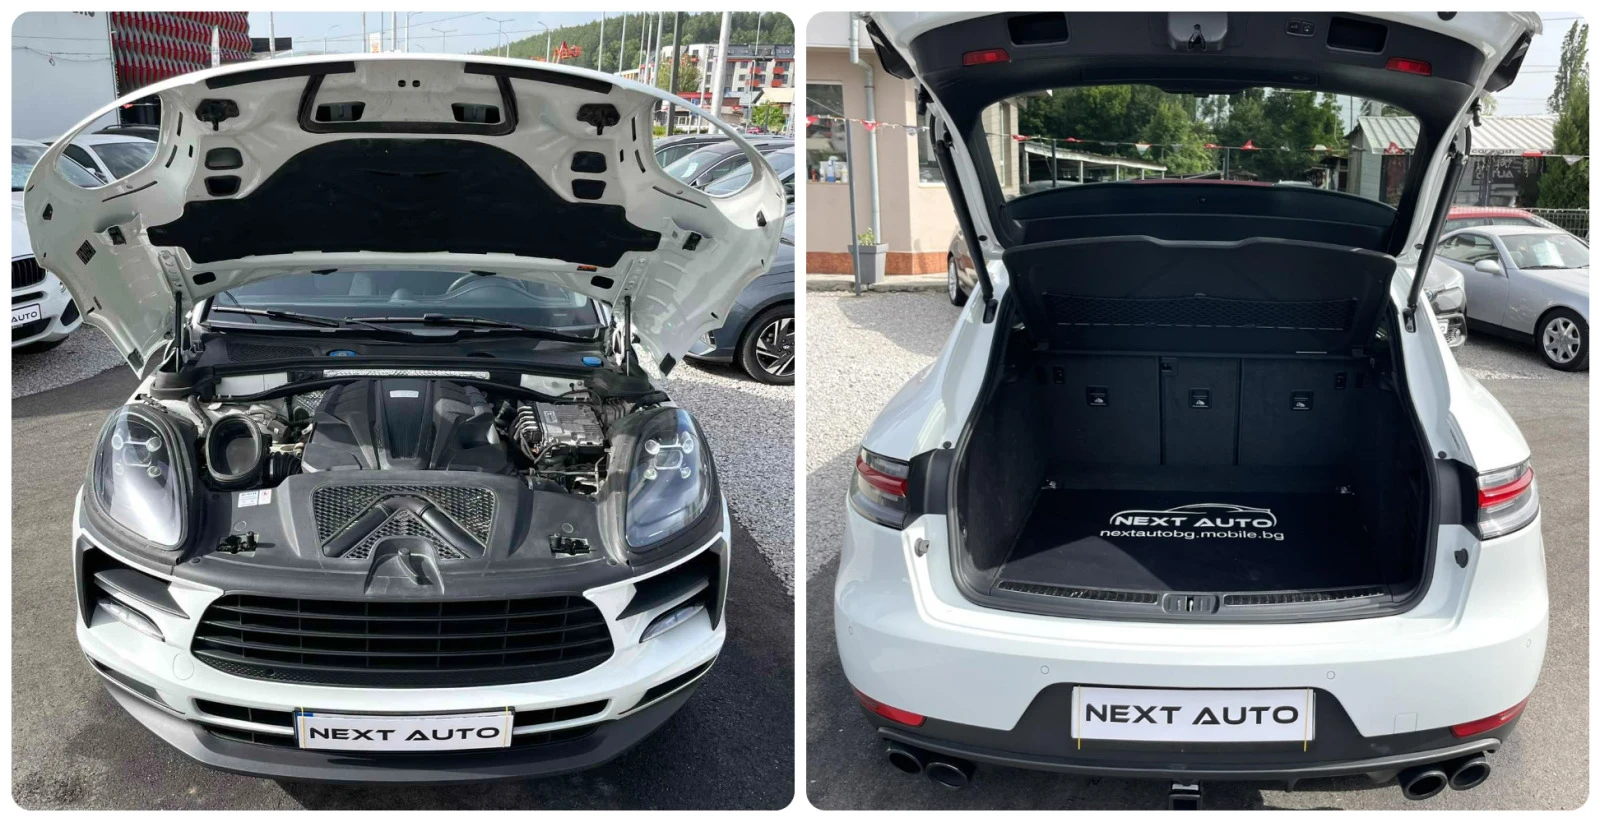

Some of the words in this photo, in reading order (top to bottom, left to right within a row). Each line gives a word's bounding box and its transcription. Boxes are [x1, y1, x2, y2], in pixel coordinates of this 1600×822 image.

[11, 311, 38, 323] AUTO
[1114, 516, 1188, 526] NEXT
[1193, 518, 1273, 528] AUTO
[1100, 530, 1285, 541] nextautobg.mobile.bg
[1085, 703, 1183, 724] NEXT
[1191, 705, 1300, 726] AUTO
[309, 727, 396, 741] NEXT
[404, 726, 501, 741] AUTO
